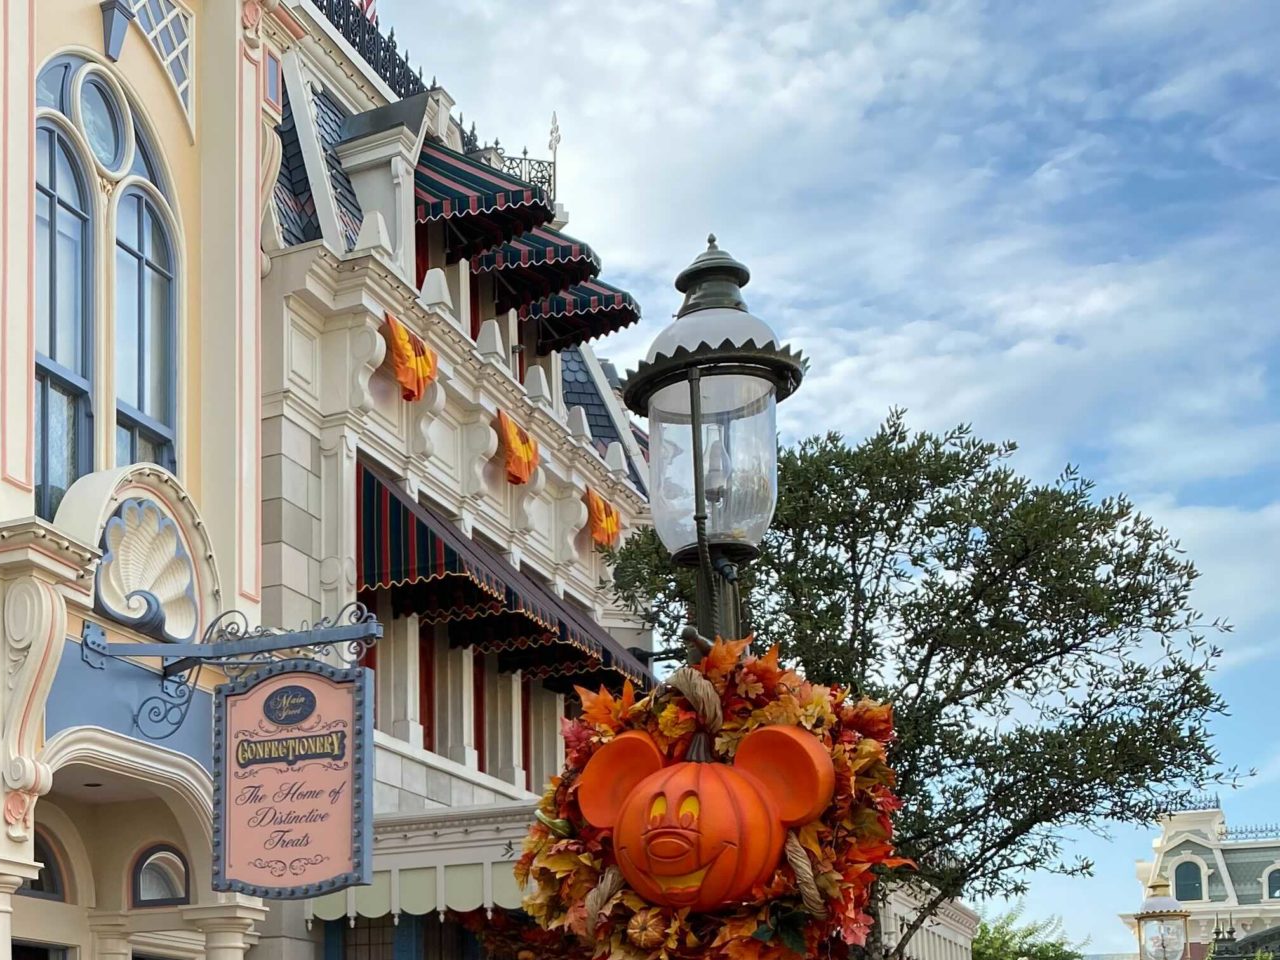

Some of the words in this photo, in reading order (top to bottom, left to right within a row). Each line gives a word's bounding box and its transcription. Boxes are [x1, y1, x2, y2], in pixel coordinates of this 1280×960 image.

[271, 693, 306, 710] Main
[275, 707, 302, 720] Street
[238, 732, 341, 763] CONFECTIONERY
[235, 784, 268, 805] The
[272, 781, 325, 804] Home
[328, 780, 347, 804] of
[247, 806, 330, 828] Distinctive
[263, 829, 312, 850] Treats
